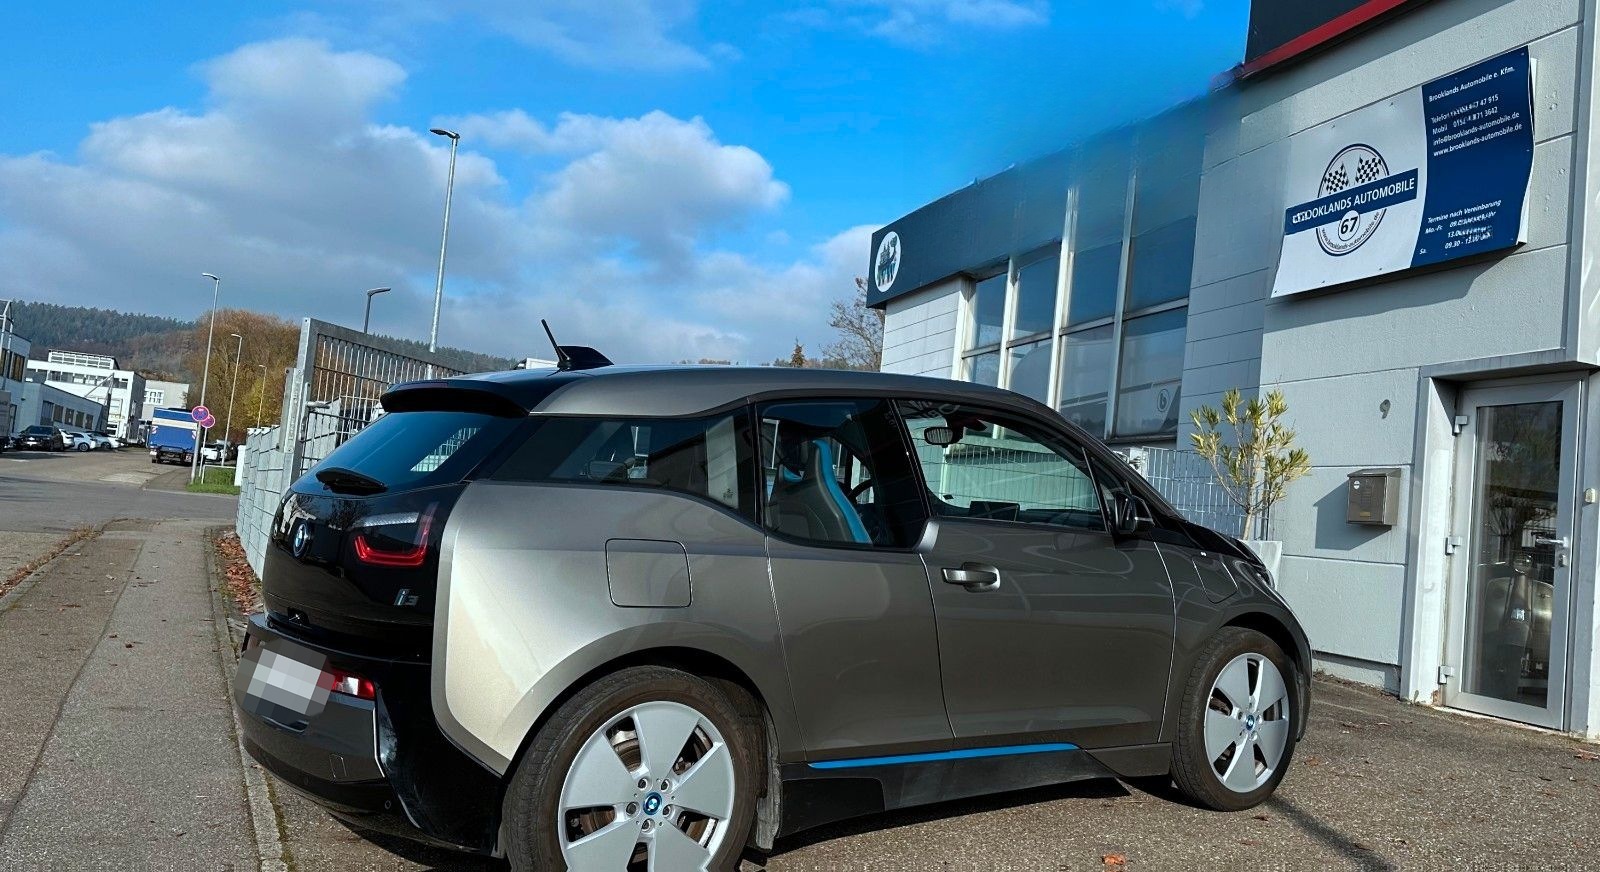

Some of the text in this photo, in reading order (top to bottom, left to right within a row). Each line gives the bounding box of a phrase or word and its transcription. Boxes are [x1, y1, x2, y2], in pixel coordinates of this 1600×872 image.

[1428, 86, 1459, 103] Brooklands
[1460, 73, 1493, 91] Automobile
[1432, 111, 1520, 146] info@brooklands-automobile.de
[1432, 123, 1448, 135] Mobil
[1433, 123, 1523, 157] www.brooklands-automobile.de
[1353, 177, 1416, 207] AUTOMOBILE
[1427, 213, 1449, 224] Termine
[1449, 209, 1463, 219] nach
[1464, 199, 1502, 215] Vereinbarung
[1340, 216, 1359, 235] 67
[1379, 398, 1391, 420] 9
[393, 588, 419, 606] i3
